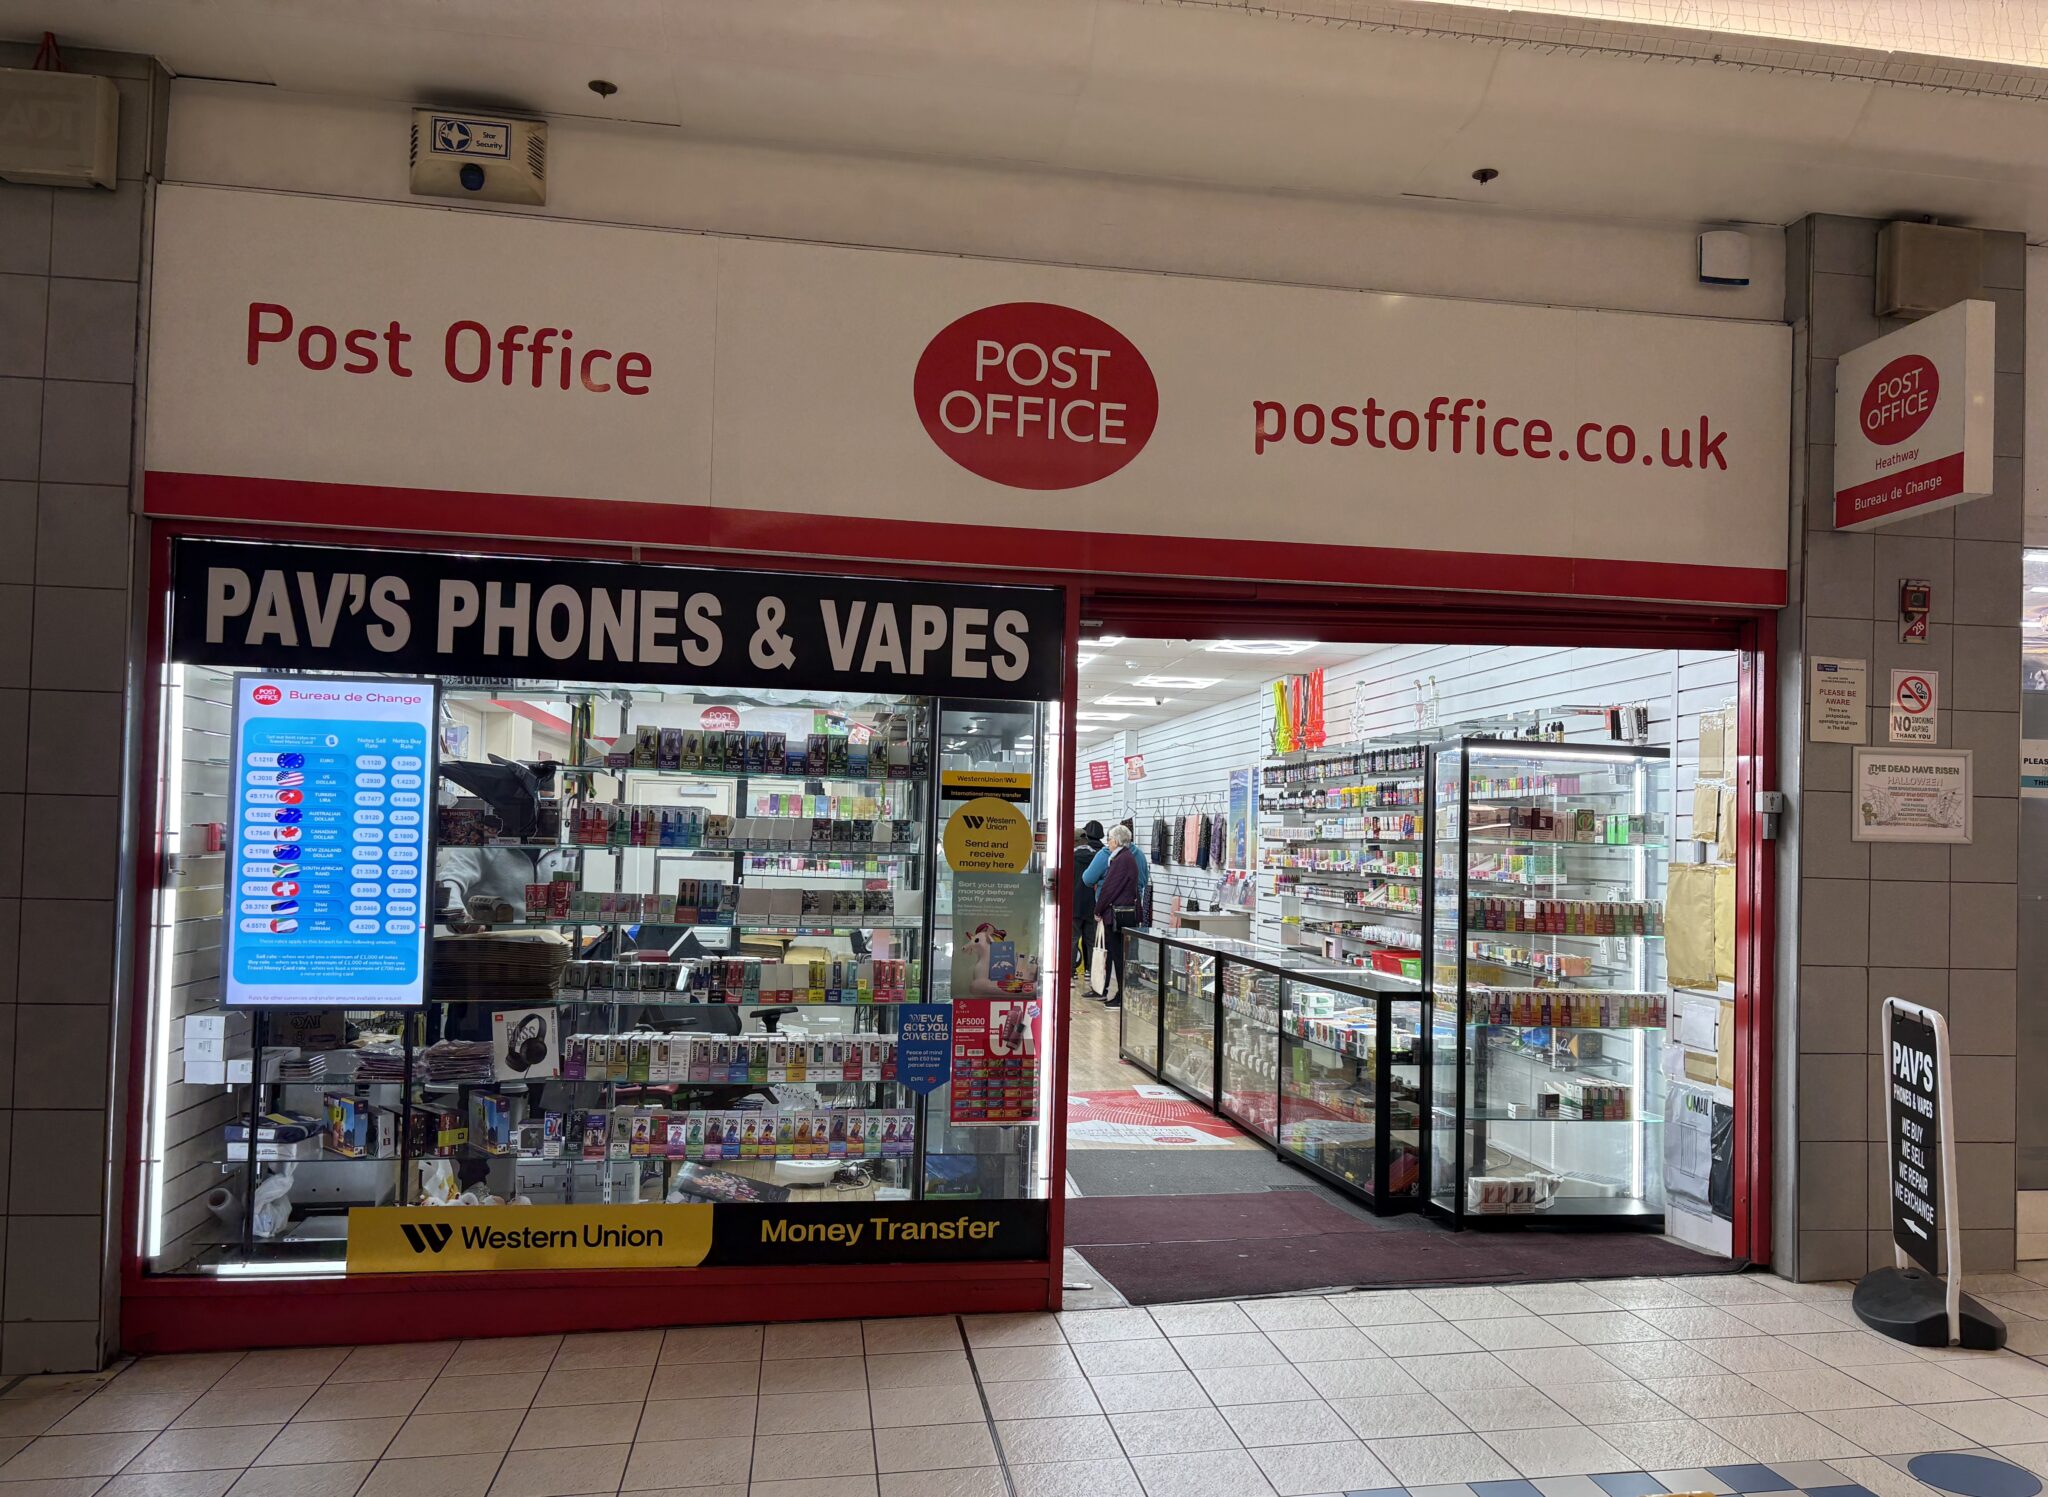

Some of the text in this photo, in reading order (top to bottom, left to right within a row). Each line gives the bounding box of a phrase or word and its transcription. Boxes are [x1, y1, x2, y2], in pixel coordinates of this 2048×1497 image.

[476, 140, 502, 150] Security
[248, 302, 652, 395] Post Office
[976, 340, 1111, 391] POST
[1878, 368, 1923, 403] POST
[939, 390, 1126, 445] OFFICE
[1867, 390, 1928, 430] OFFICE
[1253, 397, 1727, 470] postoffice.co.uk
[1876, 448, 1919, 470] Heathway
[1855, 475, 1942, 510] Bureau de Change
[206, 566, 1029, 682] PAV'S PHONES & VAPES
[1912, 622, 1924, 635] 28
[290, 691, 421, 705] Bureau de Change
[1894, 716, 1911, 731] NO
[1870, 764, 1959, 775] THE DEAD HAVE RISEN
[1888, 776, 1943, 787] HALLOWEEN
[965, 840, 989, 848] Send
[960, 860, 990, 869] money
[910, 1014, 943, 1022] WE'VE
[902, 1032, 949, 1040] COVERED
[1892, 1040, 1933, 1093] PAV'S
[1894, 1084, 1912, 1108] PHONES
[1917, 1095, 1933, 1119] VAPES
[1902, 1116, 1923, 1144] WE BUY
[1902, 1138, 1925, 1169] WE SELL
[1899, 1161, 1928, 1196] WE REPAIR
[1895, 1180, 1934, 1225] WE EXCHANGE
[461, 1224, 663, 1249] Western Union
[761, 1216, 1000, 1246] Money Transfer
